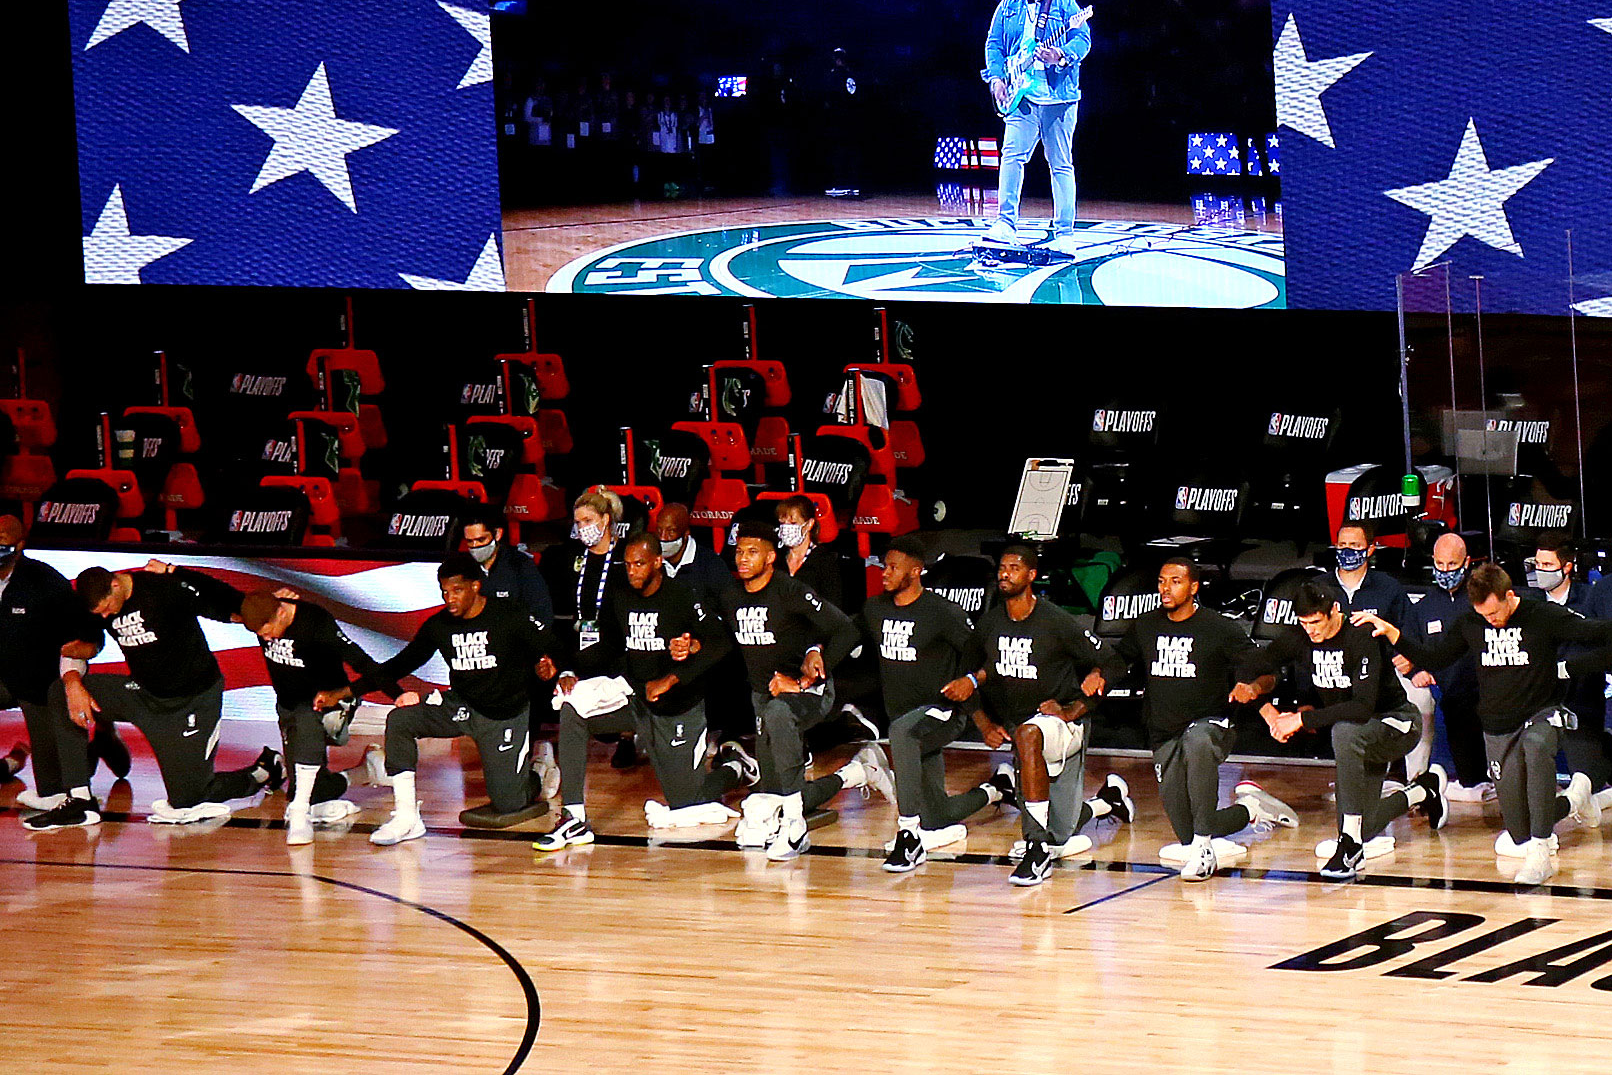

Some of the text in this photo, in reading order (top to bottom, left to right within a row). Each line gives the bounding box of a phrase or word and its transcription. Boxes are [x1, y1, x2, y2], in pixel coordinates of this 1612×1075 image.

[240, 374, 287, 396] PLAYOFFS
[1104, 410, 1156, 432] PLAYOFFS
[1279, 414, 1328, 439] PLAYOFFS
[801, 458, 853, 485] PLAYOFFS
[1186, 487, 1238, 512] PLAYOFFS
[48, 502, 101, 525] PLAYOFFS
[240, 510, 292, 532] PLAYOFFS
[1520, 504, 1572, 527] PLAYOFFS
[399, 515, 449, 537] PLAYOFFS
[736, 606, 768, 622] BLACK
[1115, 592, 1162, 620] PLAYOFF
[628, 612, 659, 626] BLACK
[739, 620, 765, 633] LIVES
[630, 624, 656, 638] LIVES
[882, 619, 915, 636] BLACK
[1484, 627, 1523, 643] BLACK
[451, 631, 488, 647] BLACK
[626, 636, 667, 651] MATTER
[735, 631, 777, 646] MATTER
[883, 632, 910, 647] LIVES
[998, 636, 1033, 654] BLACK
[1156, 635, 1194, 653] BLACK
[455, 644, 487, 659] LIVES
[879, 644, 917, 662] MATTER
[1487, 640, 1520, 654] LIVES
[451, 655, 498, 671] MATTER
[999, 650, 1029, 665] LIVES
[1158, 650, 1189, 664] LIVES
[1312, 650, 1344, 665] BLACK
[1481, 651, 1530, 666] MATTER
[995, 662, 1038, 680] MATTER
[1151, 661, 1197, 678] MATTER
[1315, 663, 1343, 677] LIVES
